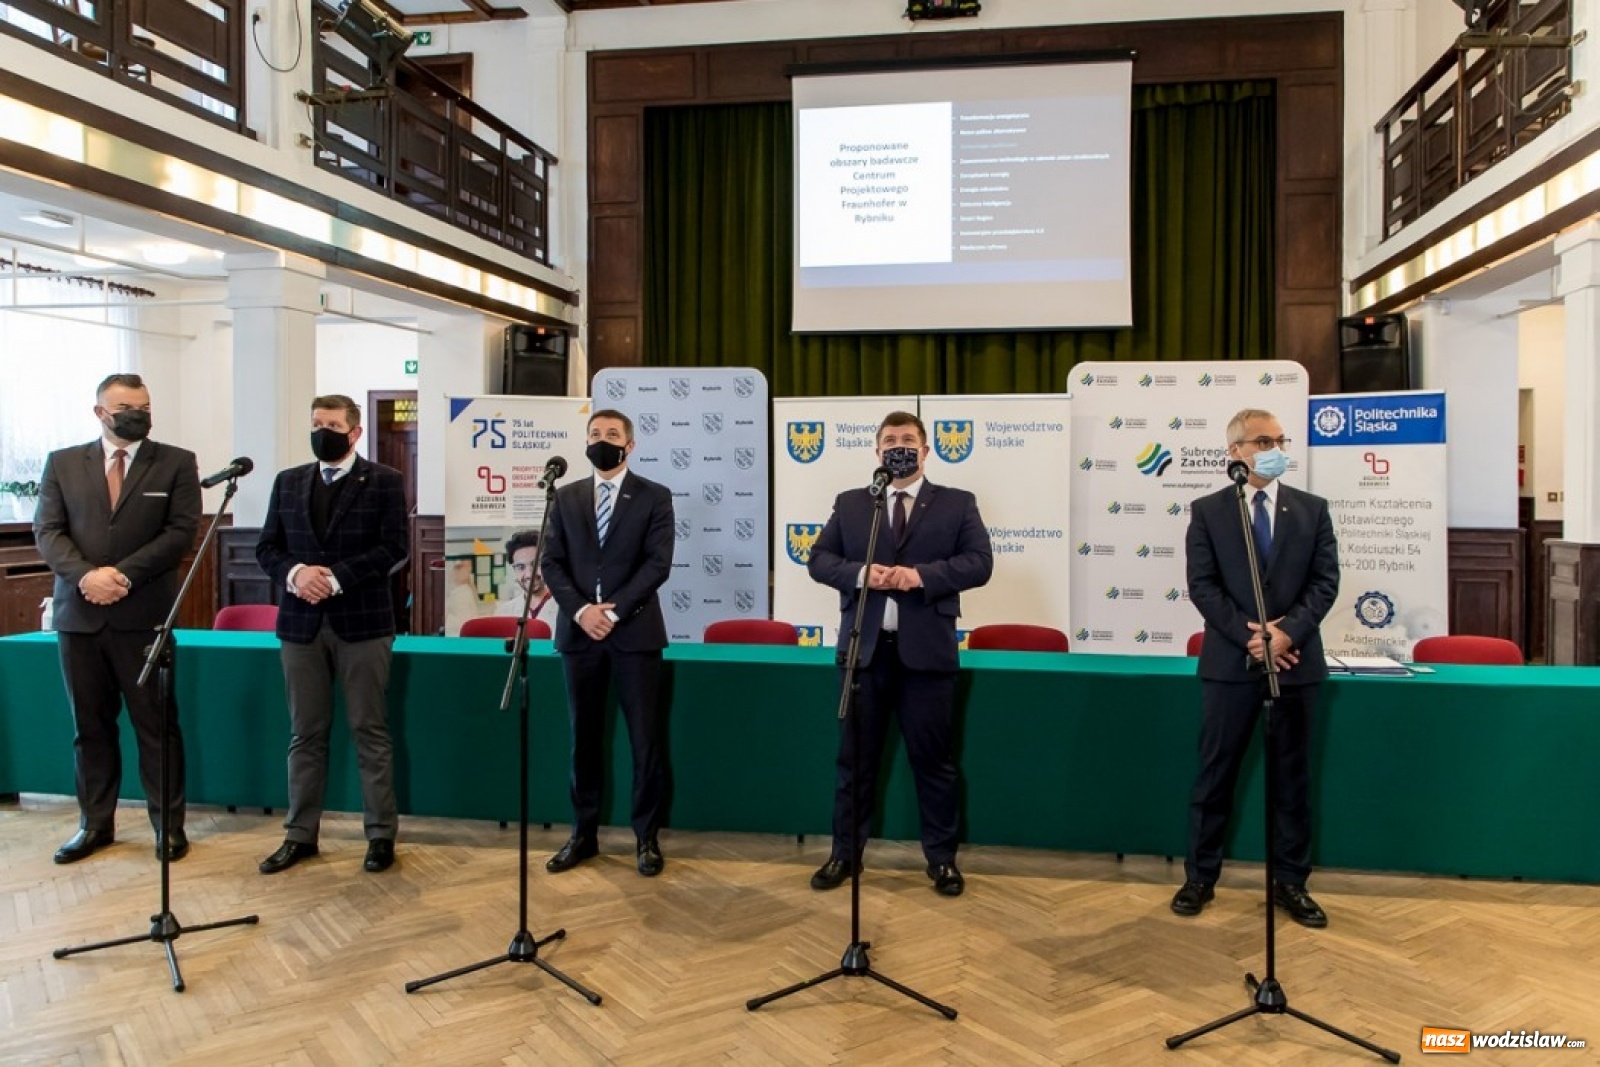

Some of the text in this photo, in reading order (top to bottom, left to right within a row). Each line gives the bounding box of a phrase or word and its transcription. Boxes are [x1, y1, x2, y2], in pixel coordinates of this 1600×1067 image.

[839, 142, 909, 153] Proponowane
[830, 155, 919, 167] obszary badawcze
[852, 171, 896, 180] Centrum
[840, 185, 909, 196] Projektowego
[841, 198, 896, 209] Fraunhofer
[854, 213, 894, 224] Rybniku
[1354, 406, 1438, 420] Politechnika
[512, 419, 534, 428] 75 lat
[836, 422, 880, 435] Wojewó
[985, 421, 1063, 434] Województwo
[1354, 419, 1397, 433] Śląska
[512, 430, 568, 439] POLITECHNIKI
[836, 436, 873, 450] Śląskie
[985, 435, 1024, 449] Śląskie
[1181, 446, 1229, 458] Subregio
[1328, 498, 1432, 510] entrum Kształcenia
[1338, 513, 1414, 528] Ustawicznego
[1340, 528, 1394, 538] Politechniki
[1395, 527, 1432, 542] Śląskiej
[991, 541, 1025, 554] ląskie
[1348, 542, 1405, 554] Kościuszki
[1407, 543, 1421, 555] 54
[1378, 559, 1415, 573] Rybnik
[1343, 633, 1407, 647] Akademickie
